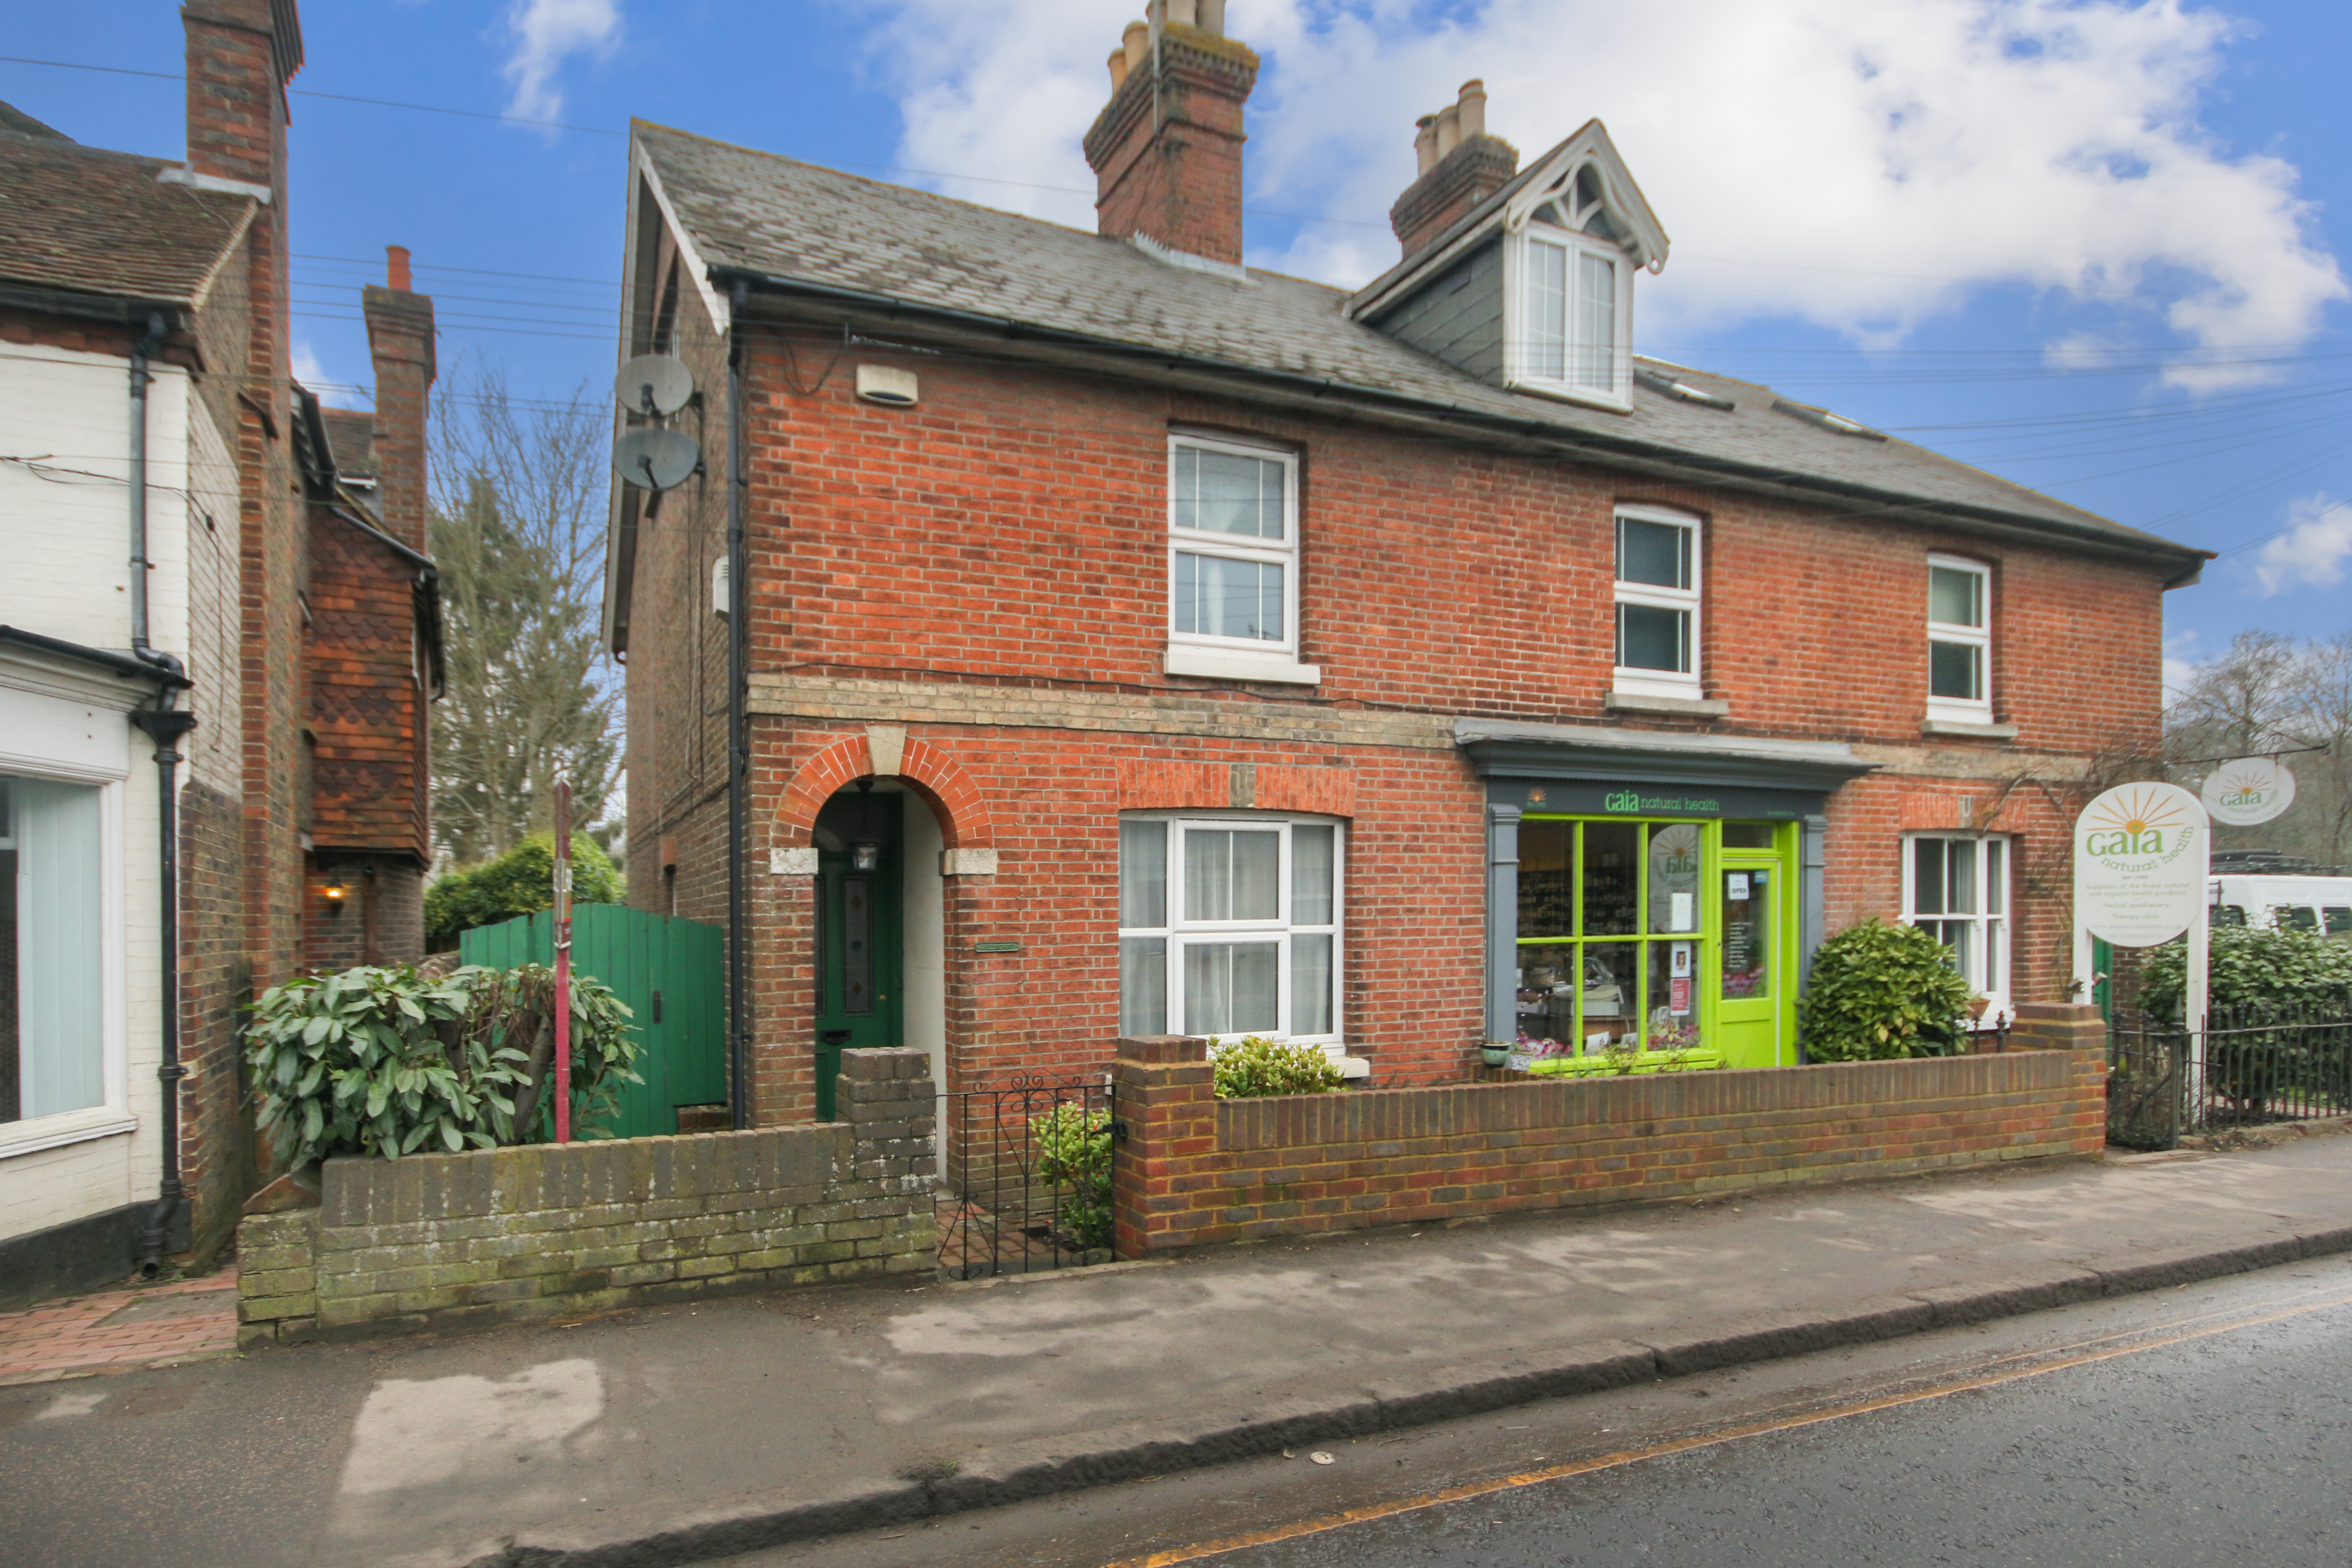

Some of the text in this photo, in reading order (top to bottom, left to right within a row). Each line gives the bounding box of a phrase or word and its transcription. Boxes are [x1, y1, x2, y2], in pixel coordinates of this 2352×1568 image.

[1641, 797, 1682, 809] natural
[1685, 798, 1720, 811] health
[2220, 792, 2262, 806] Gaia
[2087, 830, 2164, 856] Gaia
[2101, 827, 2194, 872] natural health
